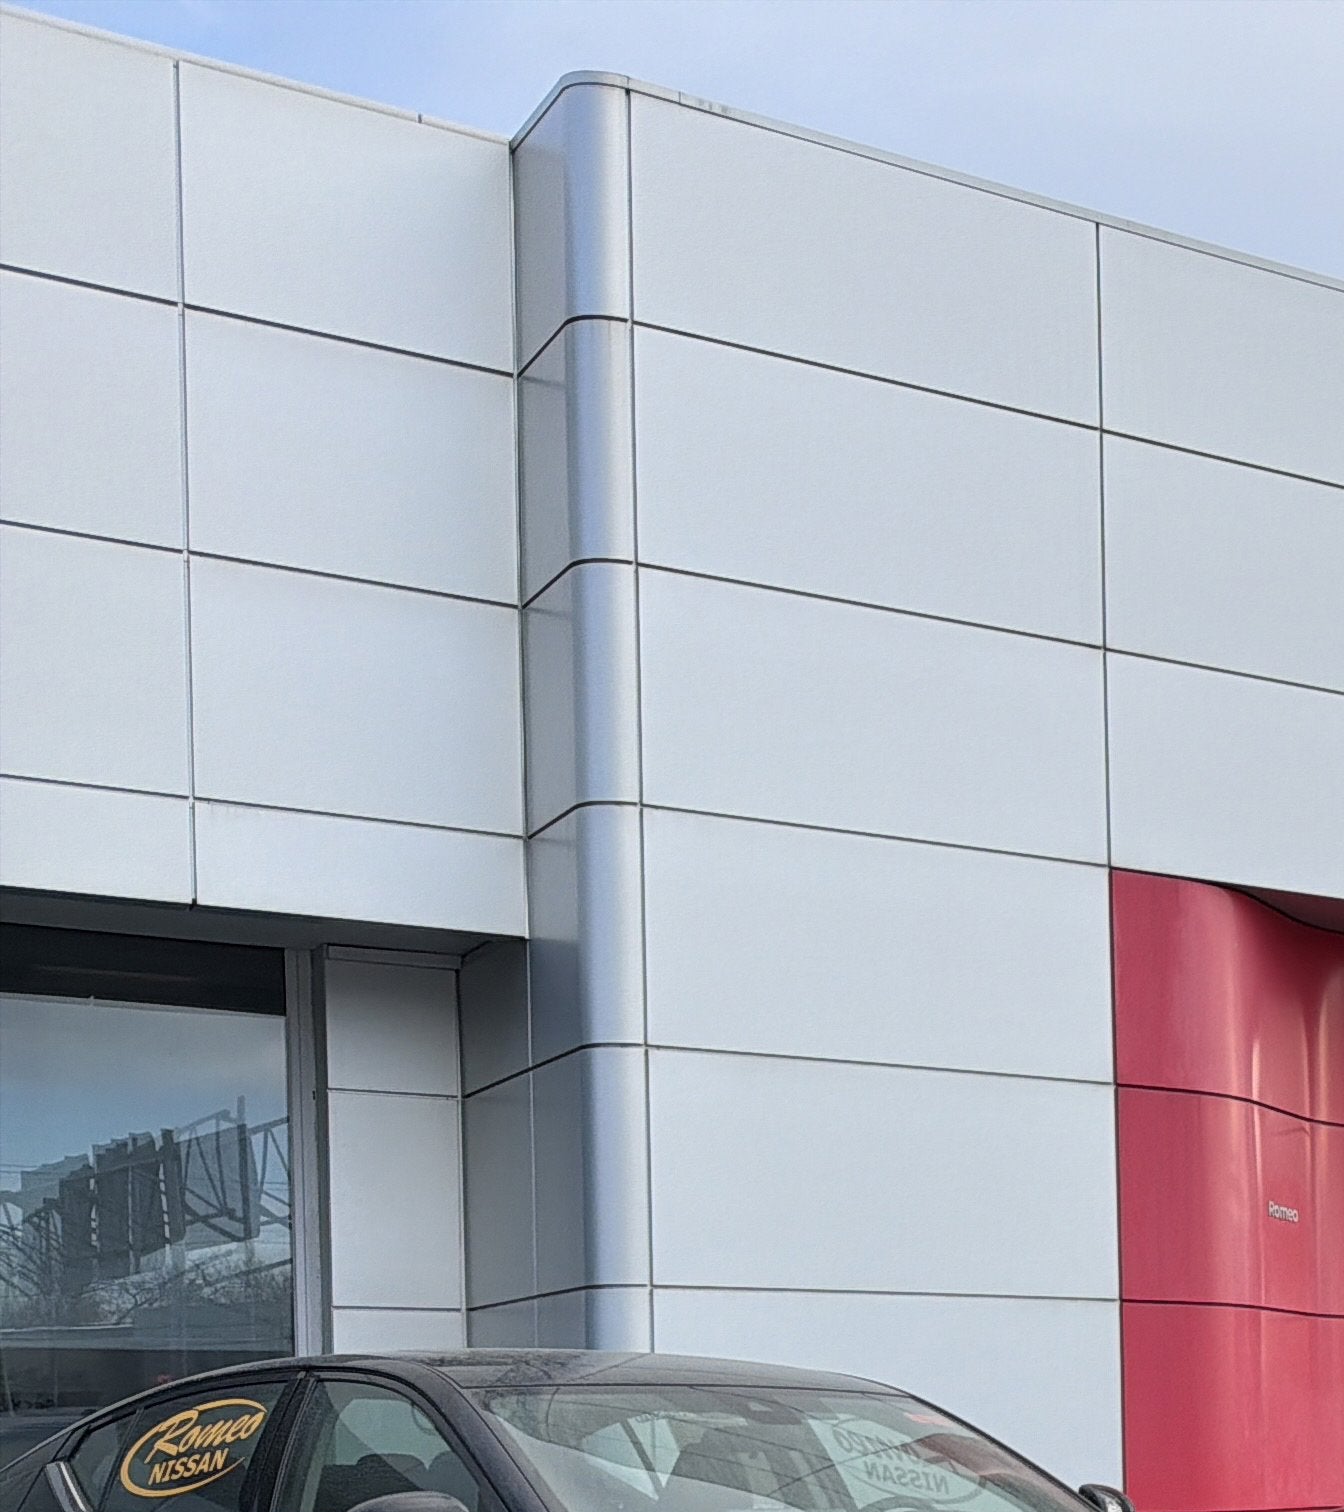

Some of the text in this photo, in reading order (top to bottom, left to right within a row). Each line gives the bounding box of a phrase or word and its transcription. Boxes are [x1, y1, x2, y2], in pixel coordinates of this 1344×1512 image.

[1268, 1200, 1299, 1223] Romeo
[144, 1409, 266, 1465] Romeo
[148, 1448, 230, 1486] NISSAN
